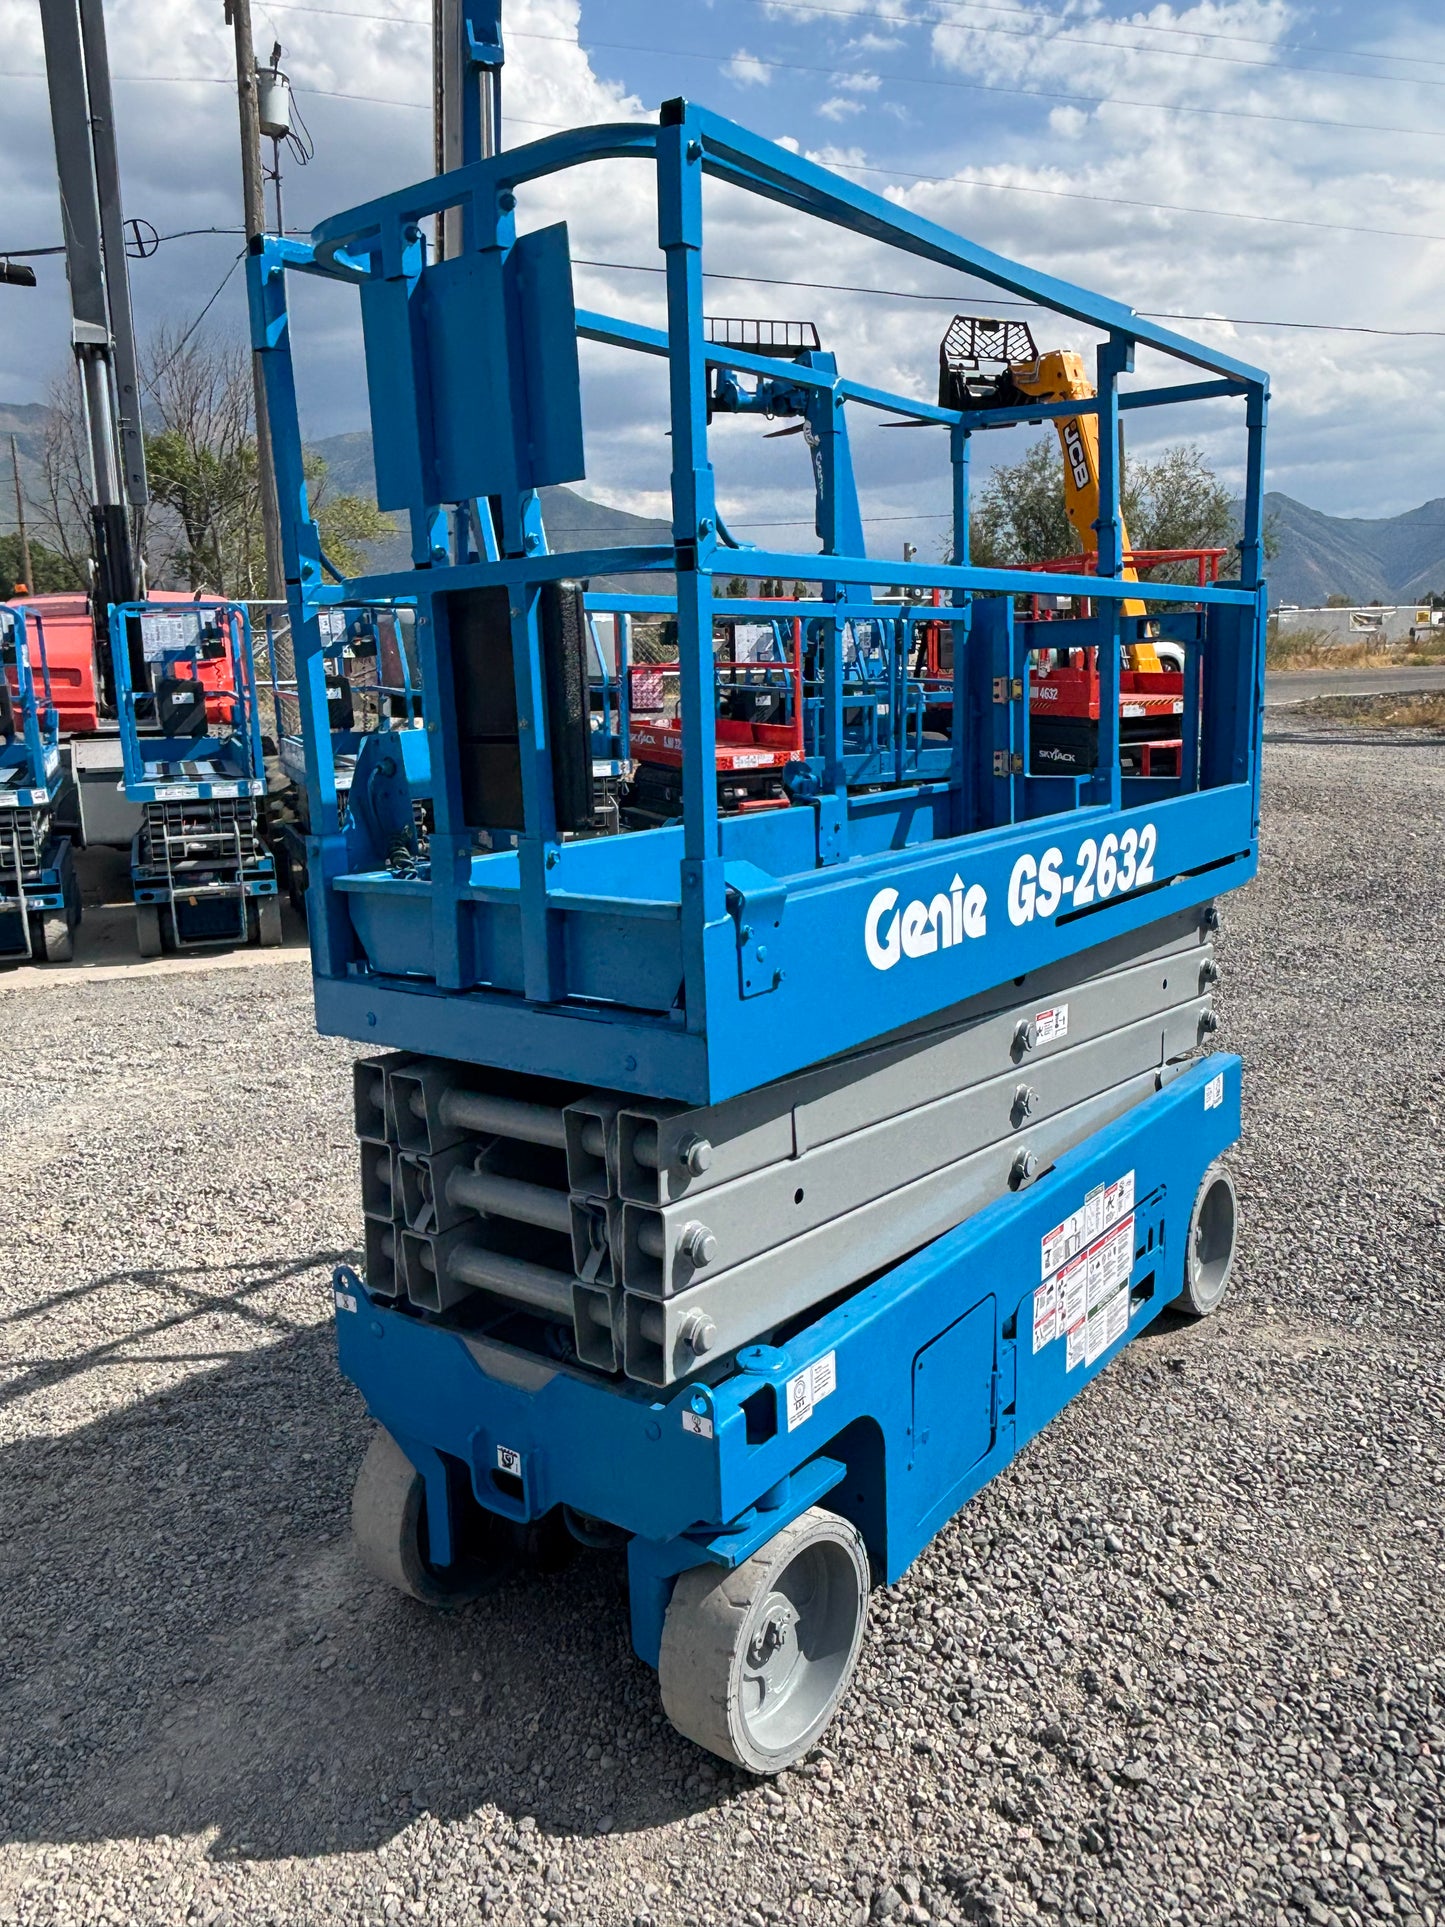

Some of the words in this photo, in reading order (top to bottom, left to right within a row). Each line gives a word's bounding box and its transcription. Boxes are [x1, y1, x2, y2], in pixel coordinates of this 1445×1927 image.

[1064, 423, 1090, 489] JCB
[1040, 687, 1058, 700] 4632
[1038, 748, 1076, 762] SKYJACK
[864, 872, 987, 970] Genie
[1007, 823, 1157, 927] GS-2632
